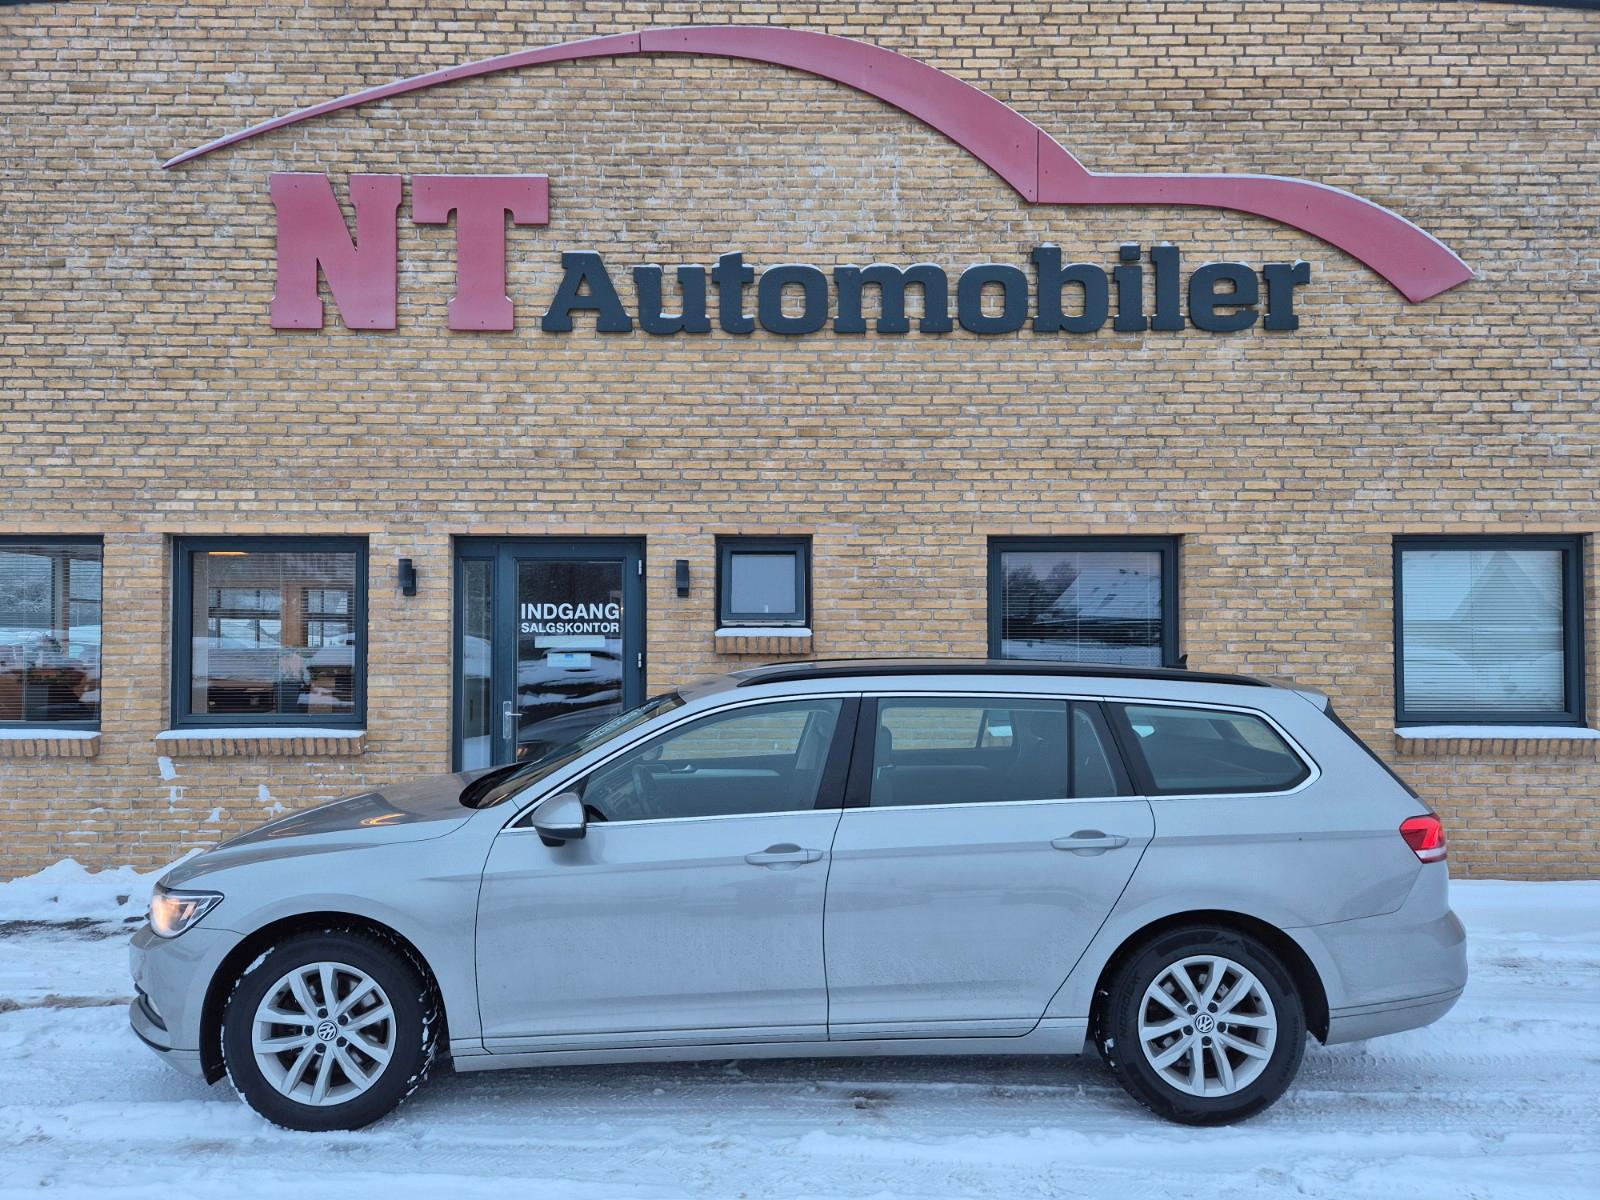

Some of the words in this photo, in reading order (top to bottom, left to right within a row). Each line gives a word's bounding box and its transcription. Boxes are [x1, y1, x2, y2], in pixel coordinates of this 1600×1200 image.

[270, 172, 549, 331] NT
[542, 247, 1310, 334] Automobiler
[521, 603, 620, 619] INDGANG
[521, 622, 620, 633] SALGSKONTOR
